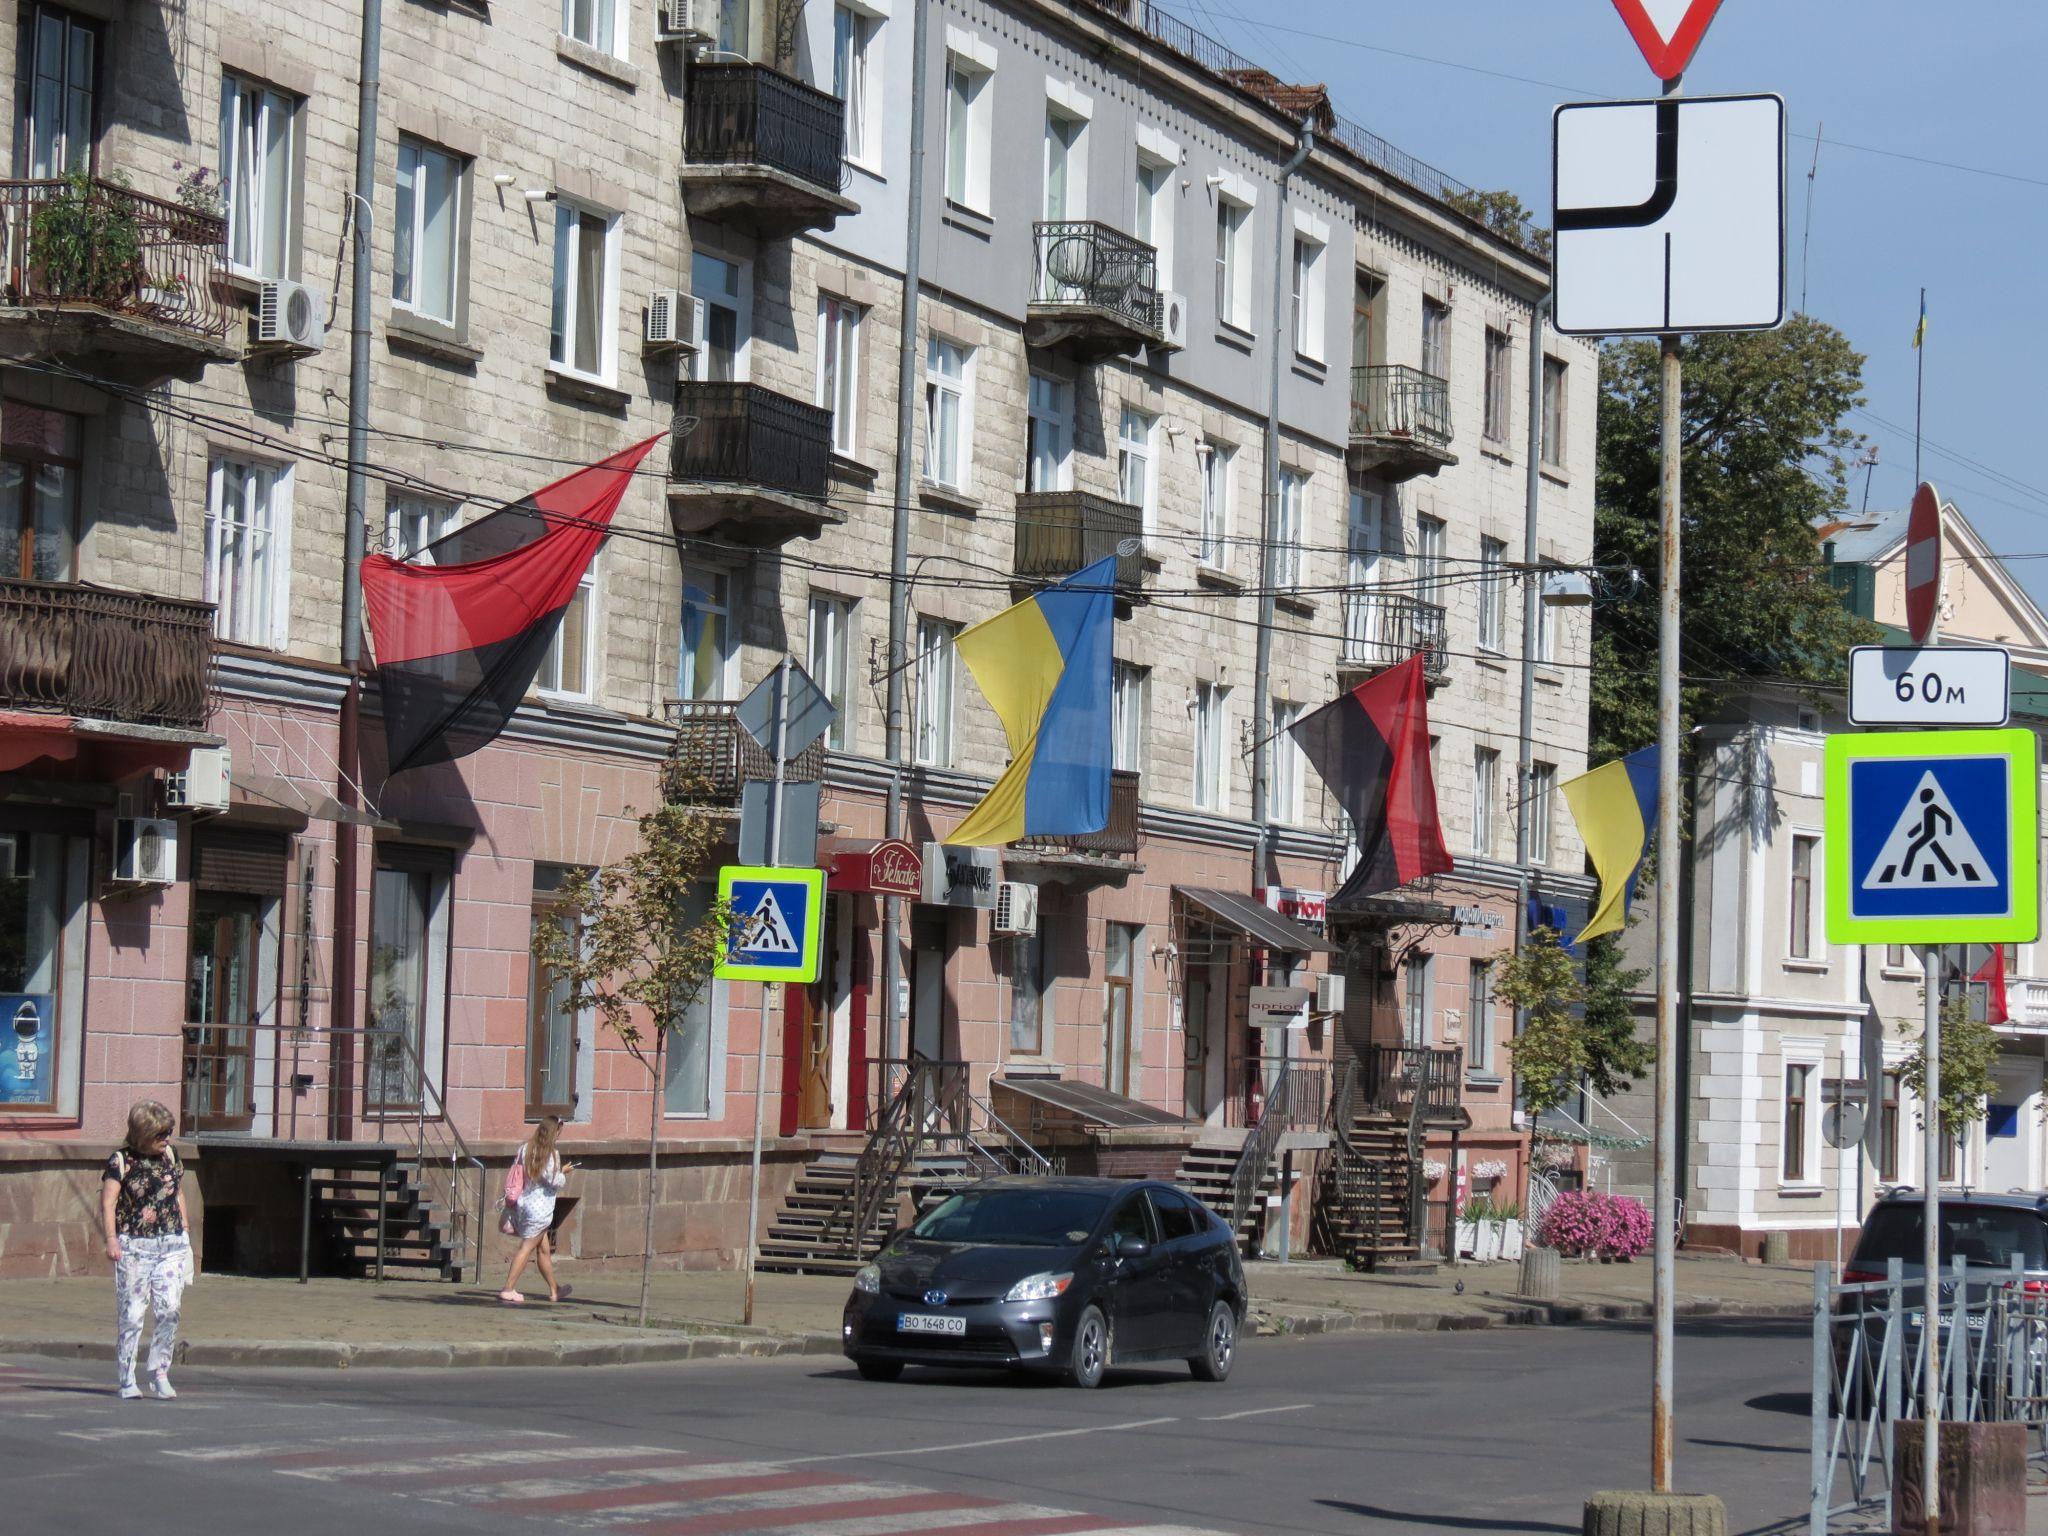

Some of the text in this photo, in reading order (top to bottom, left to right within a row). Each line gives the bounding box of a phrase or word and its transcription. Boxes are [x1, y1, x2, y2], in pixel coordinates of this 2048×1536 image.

[904, 1316, 963, 1331] BO 1648 CO
